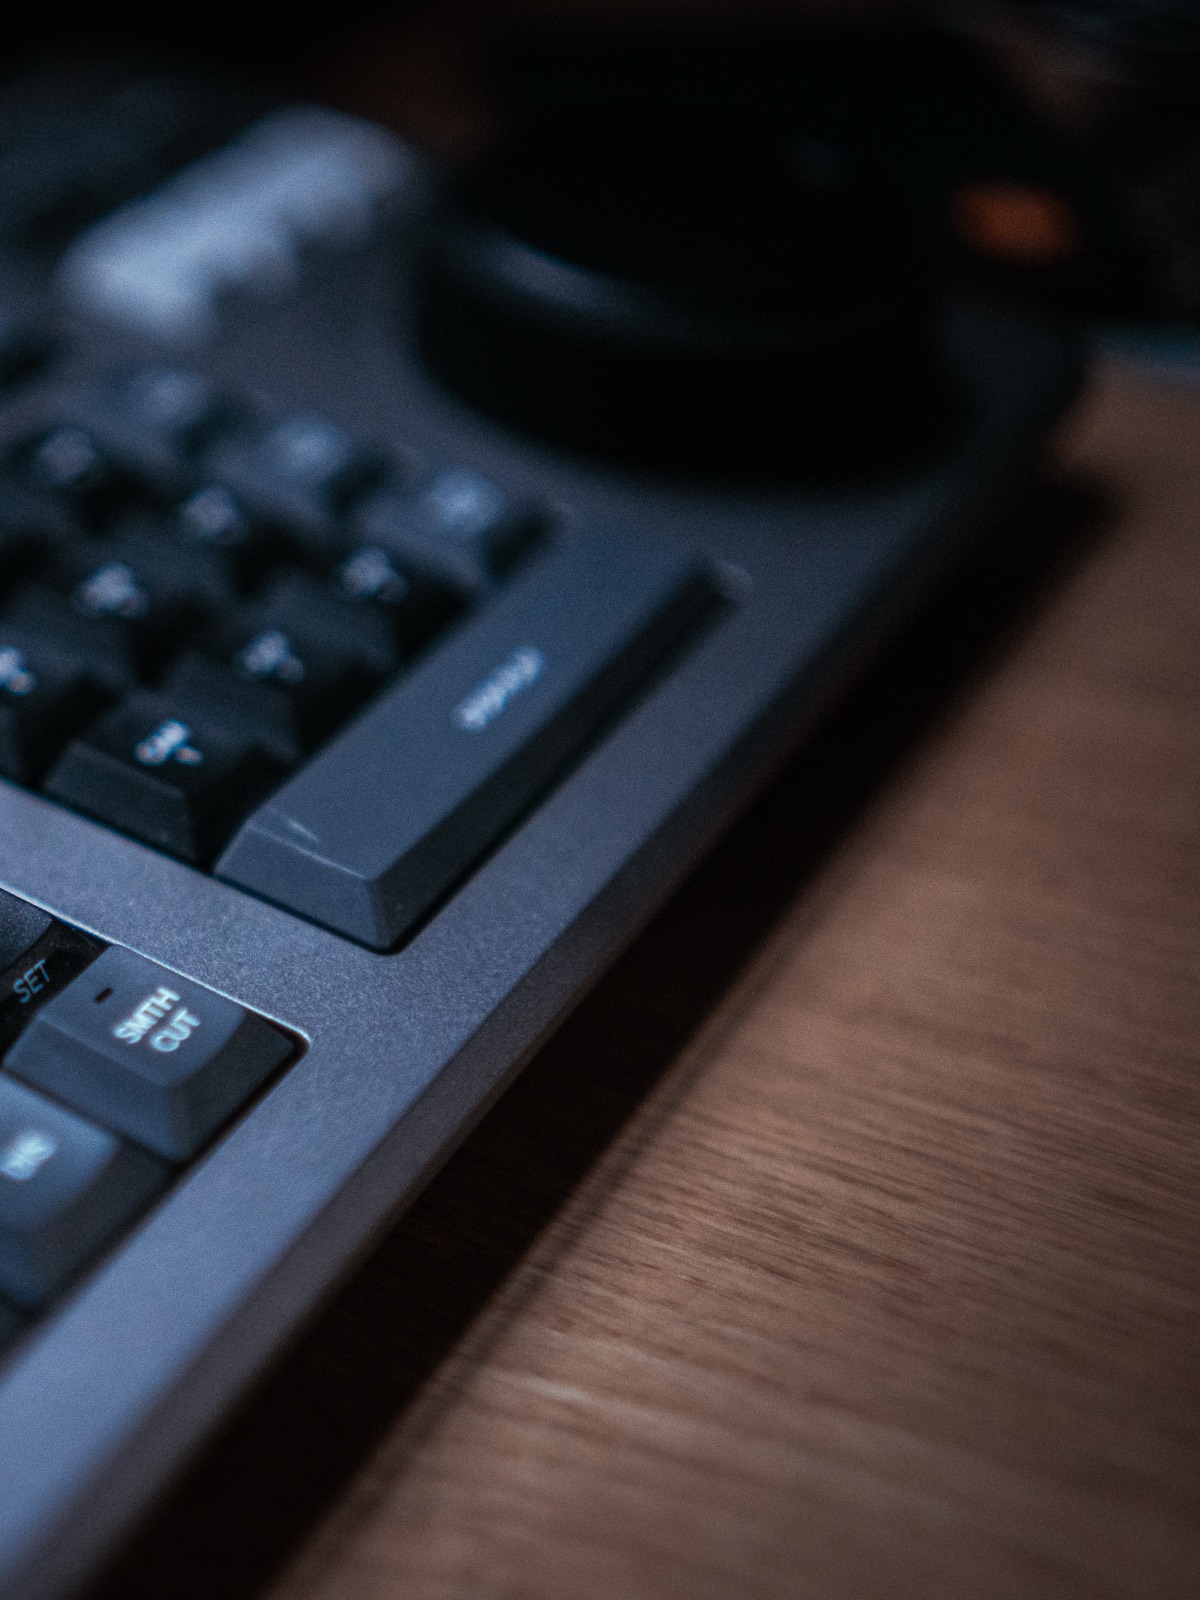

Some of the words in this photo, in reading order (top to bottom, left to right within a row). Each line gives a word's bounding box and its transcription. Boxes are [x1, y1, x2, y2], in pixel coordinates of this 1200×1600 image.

[13, 959, 51, 1004] SET
[112, 985, 180, 1045] SMTH
[148, 1008, 201, 1053] CUT
